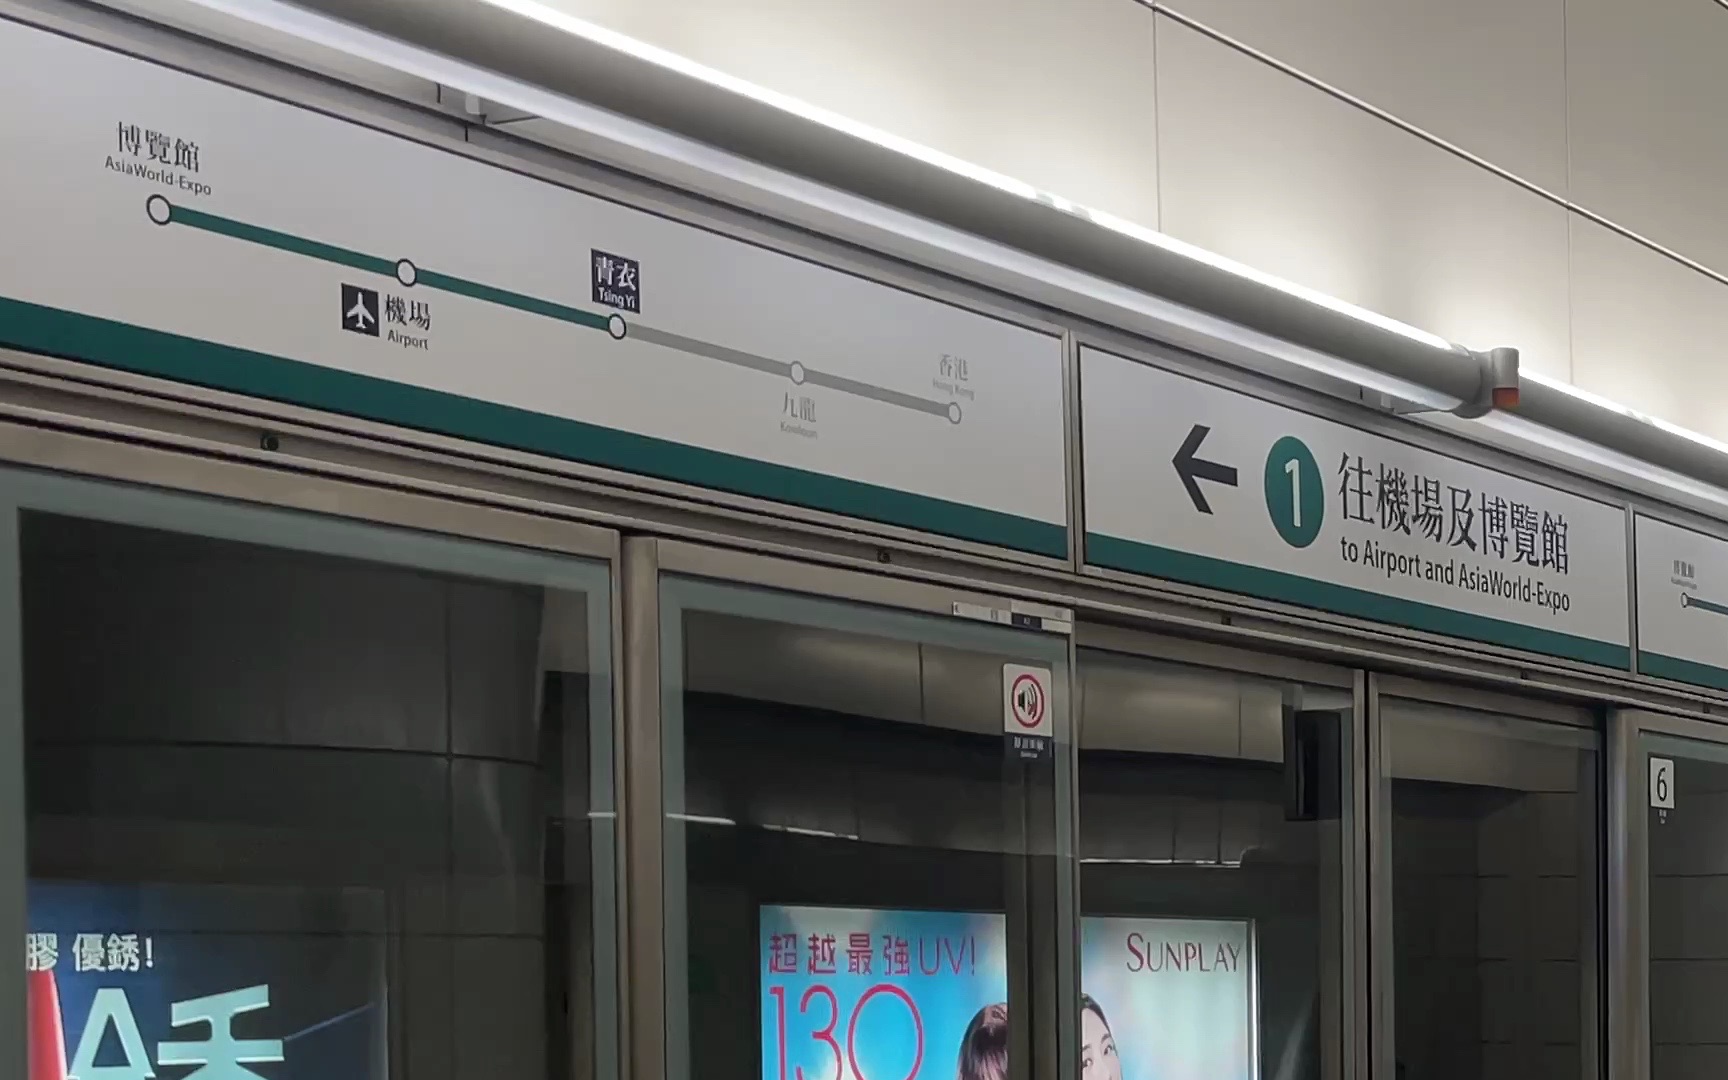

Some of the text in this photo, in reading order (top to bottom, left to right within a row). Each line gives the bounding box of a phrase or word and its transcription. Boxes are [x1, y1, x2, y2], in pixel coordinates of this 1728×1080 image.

[117, 120, 199, 173] 博覽館
[104, 155, 212, 196] AsiaWorld-Expo
[384, 293, 431, 331] 機場
[598, 286, 635, 309] Tsing Yi
[387, 329, 429, 351] Airport
[1284, 457, 1303, 528] 1
[1337, 451, 1569, 576] 往機場及博覽館
[1340, 536, 1571, 615] to Airport and AsiaWorld-Expo
[1656, 766, 1668, 802] 6
[1125, 932, 1241, 974] SUNPLAY
